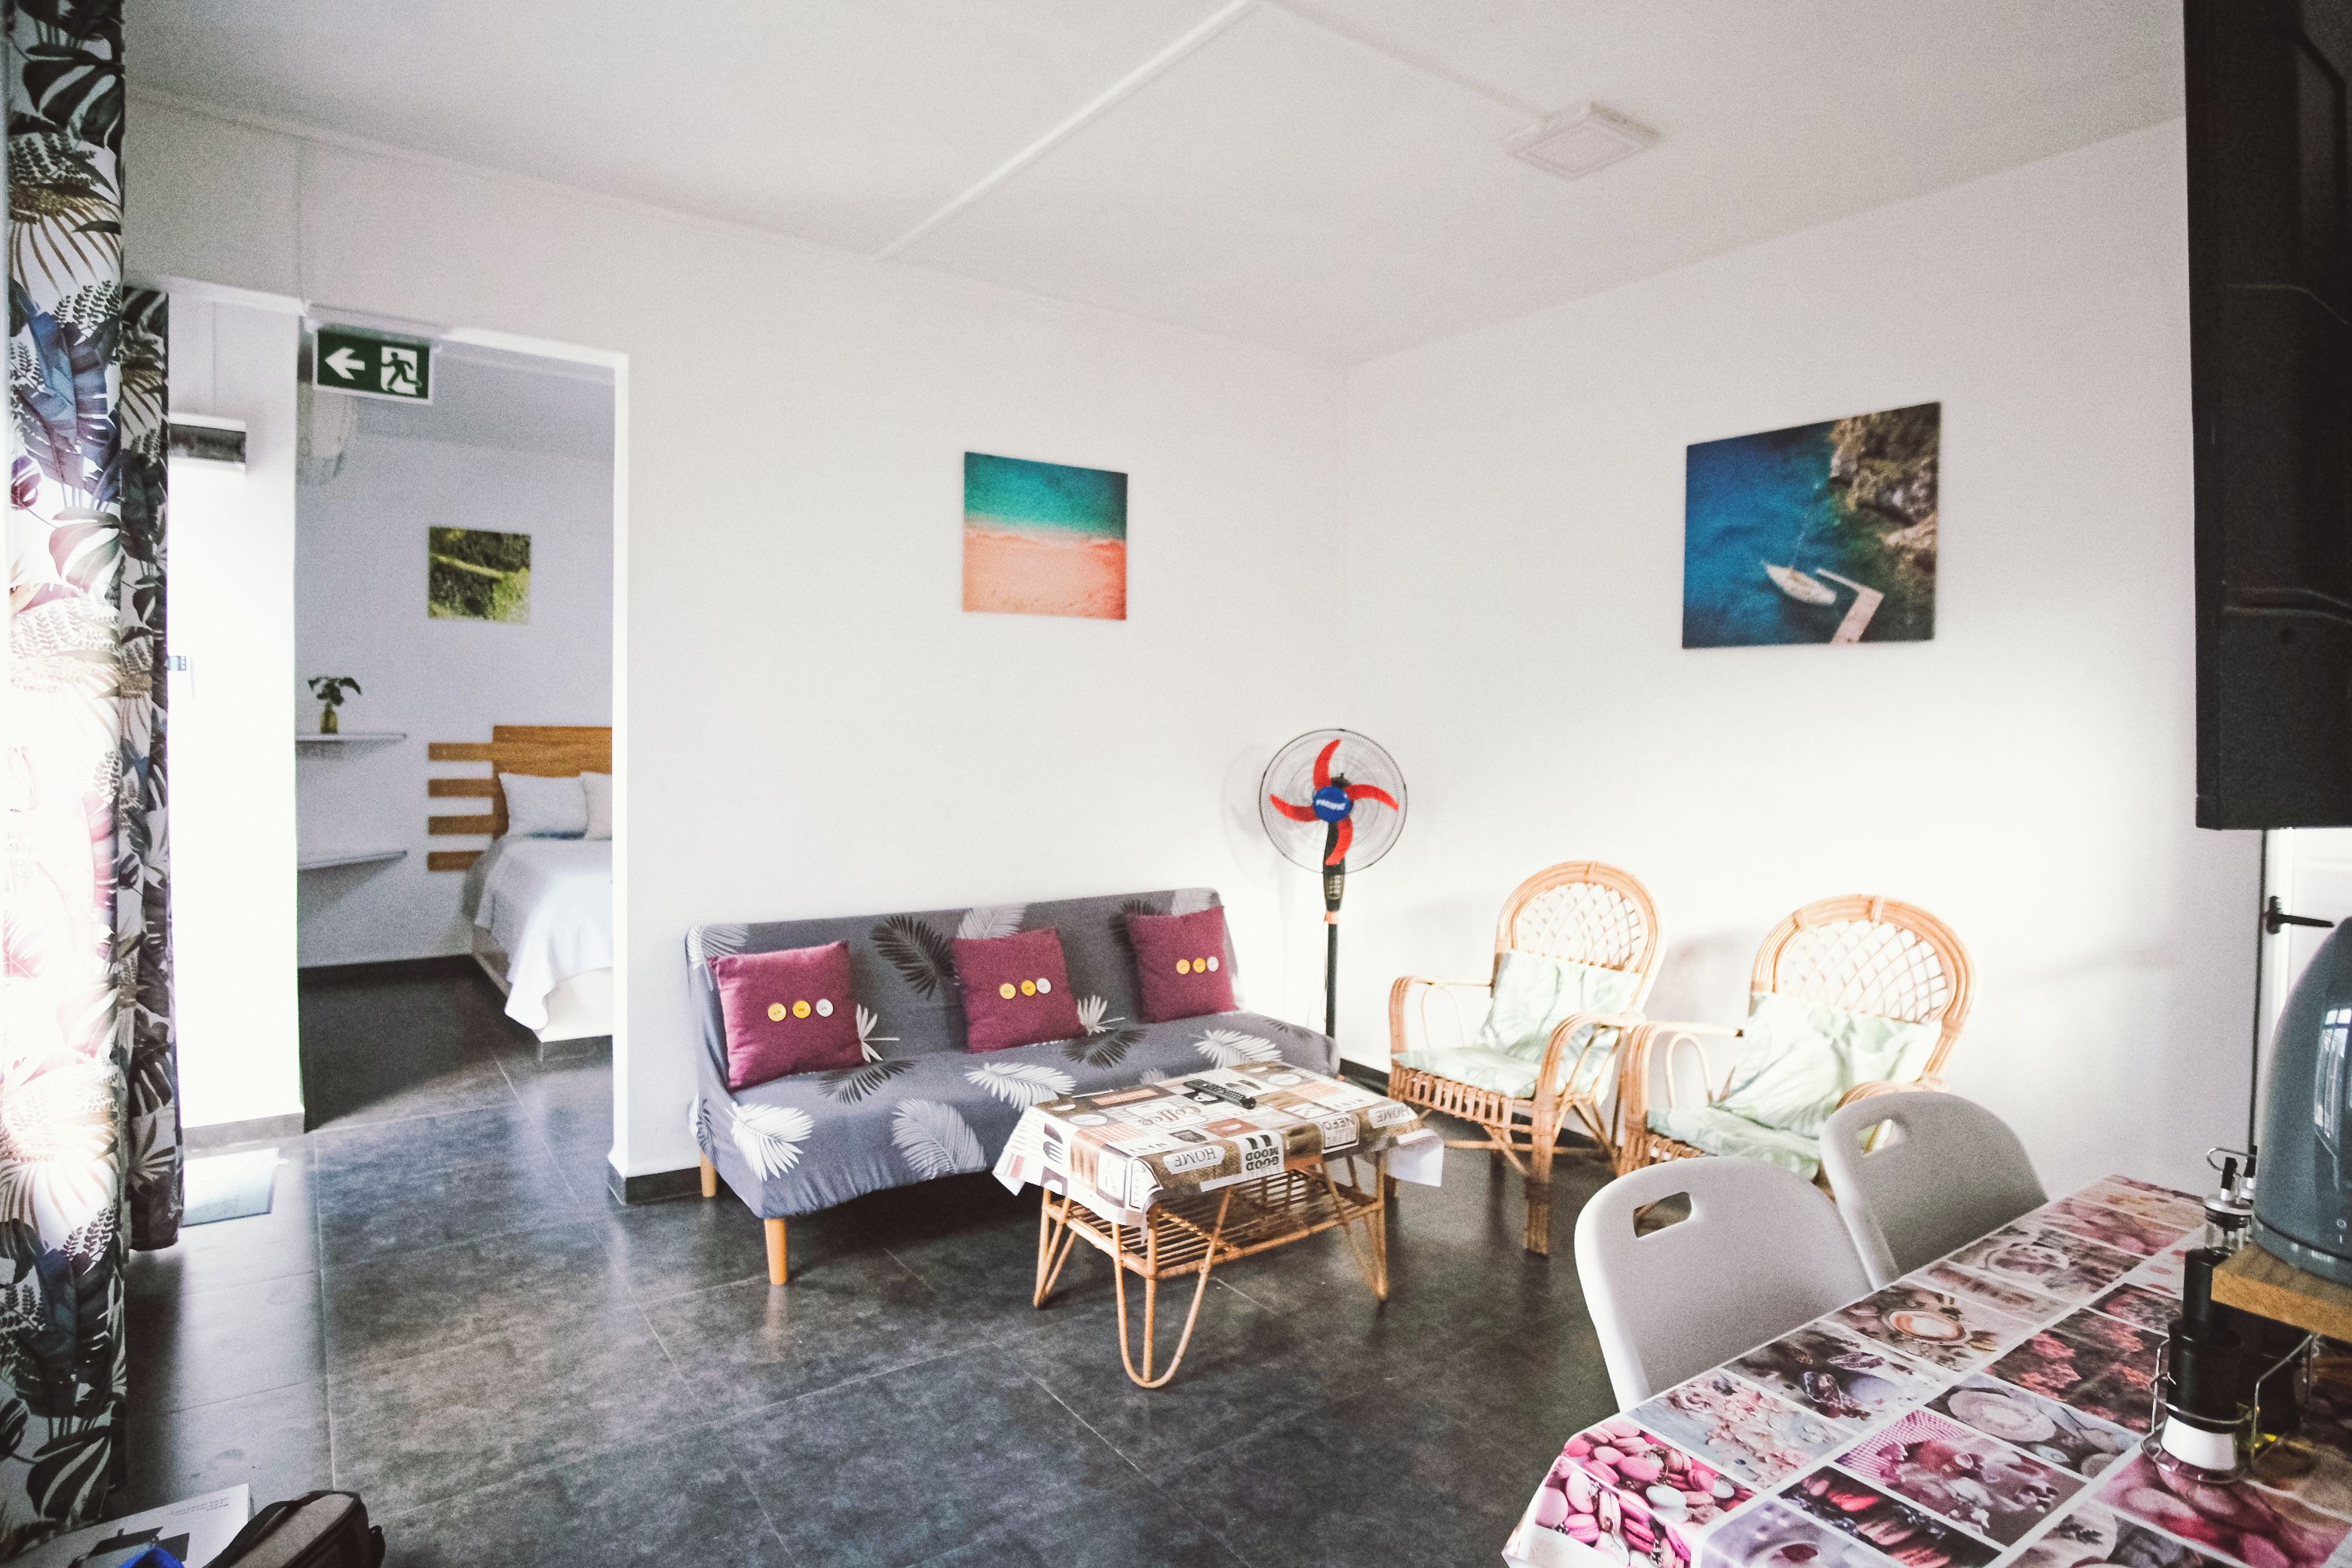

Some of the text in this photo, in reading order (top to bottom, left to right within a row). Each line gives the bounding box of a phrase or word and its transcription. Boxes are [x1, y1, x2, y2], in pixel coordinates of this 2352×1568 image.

[1139, 1106, 1202, 1125] Coffee
[1375, 1105, 1410, 1122] HOME
[1174, 1147, 1217, 1168] HOME
[1245, 1146, 1279, 1162] MOOD
[1246, 1156, 1279, 1171] GOOD
